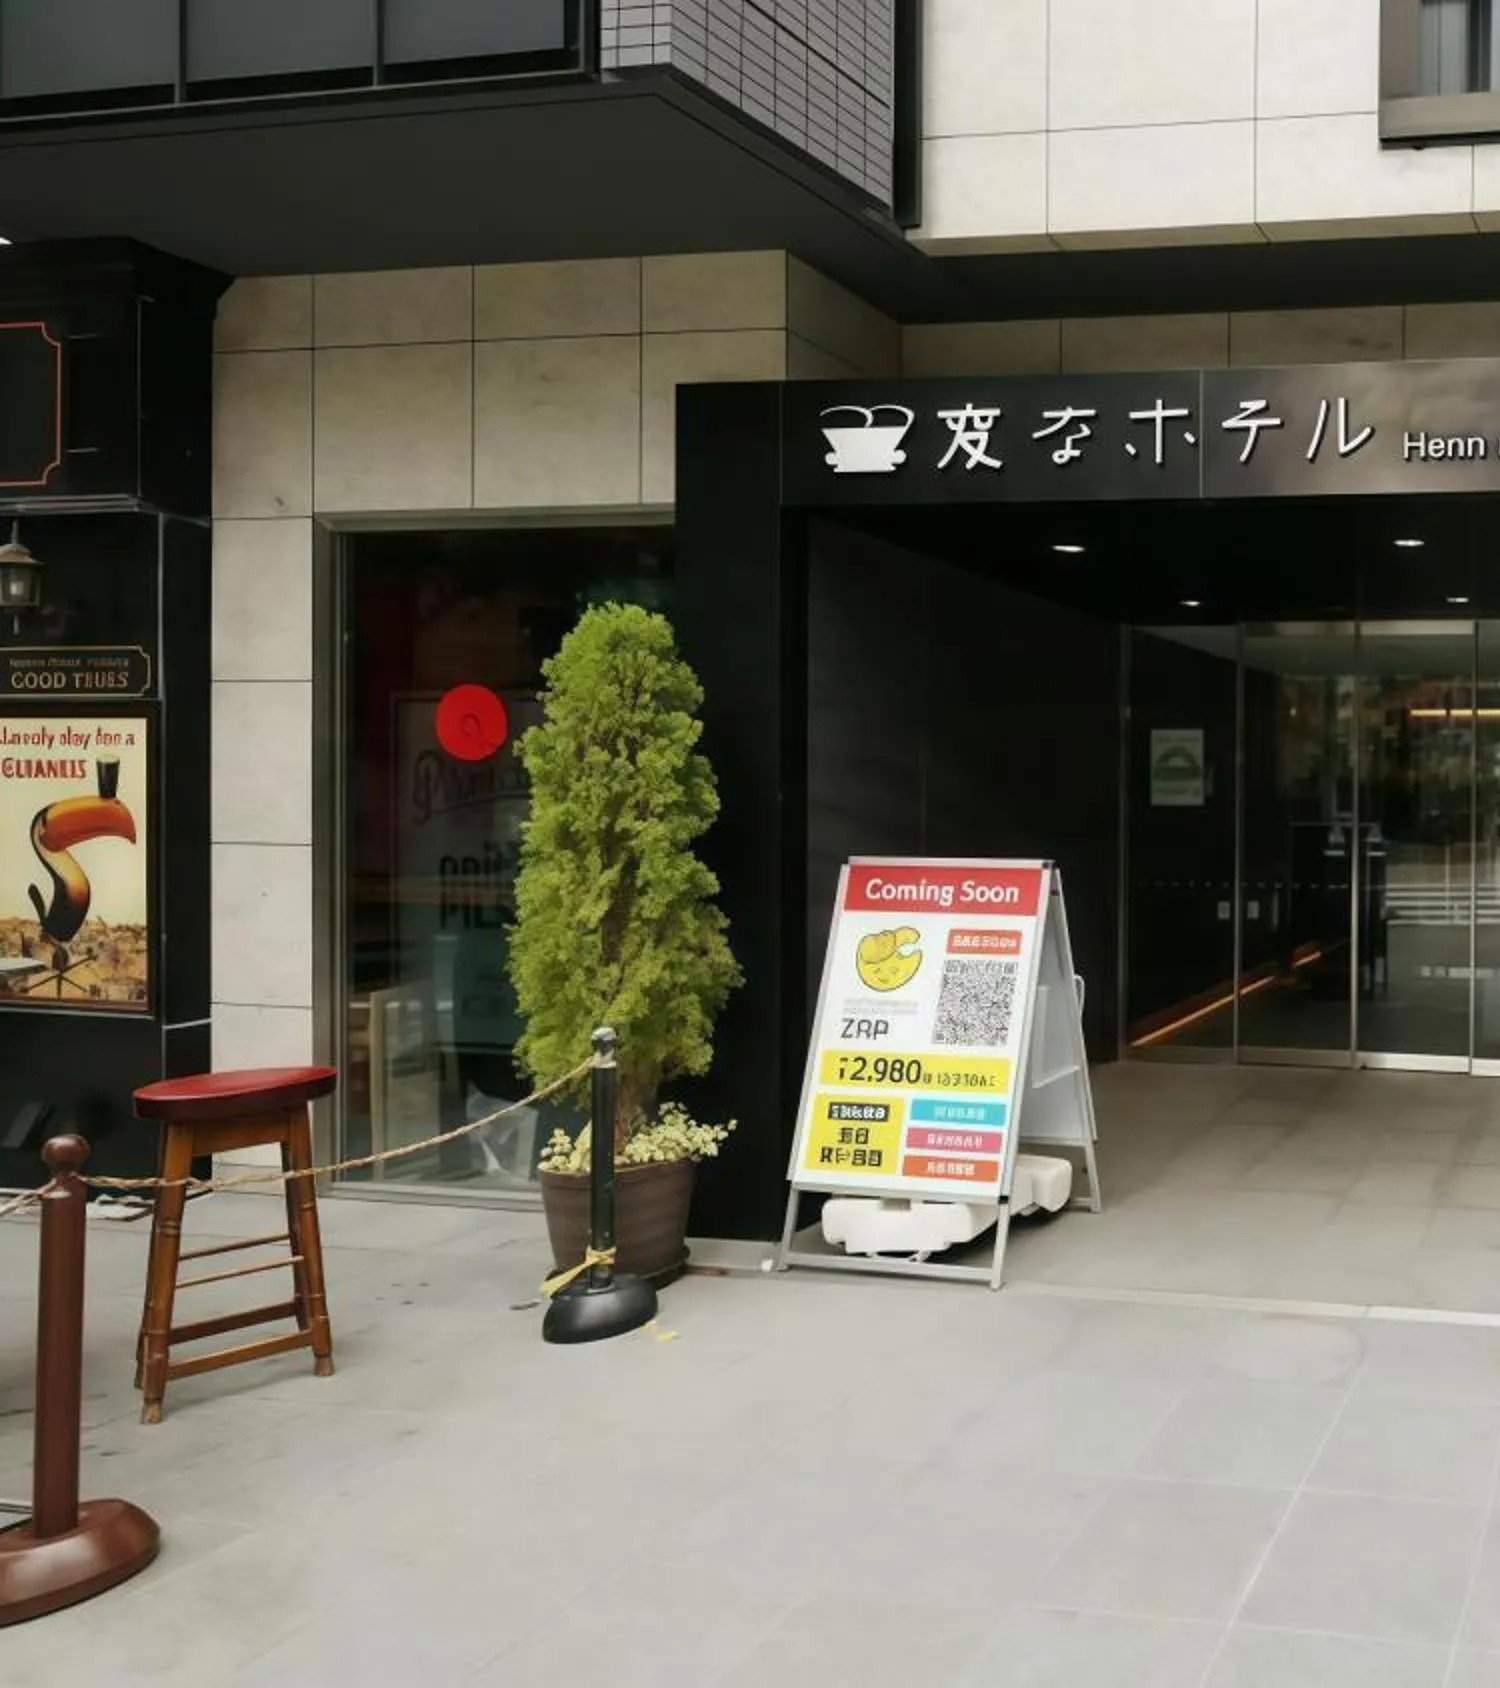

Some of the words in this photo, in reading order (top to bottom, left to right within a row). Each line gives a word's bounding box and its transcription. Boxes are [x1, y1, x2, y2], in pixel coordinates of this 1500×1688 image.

[937, 397, 1373, 470] 変なホテル
[1403, 431, 1486, 460] Henn
[865, 877, 955, 907] Coming
[960, 879, 1020, 903] Soon
